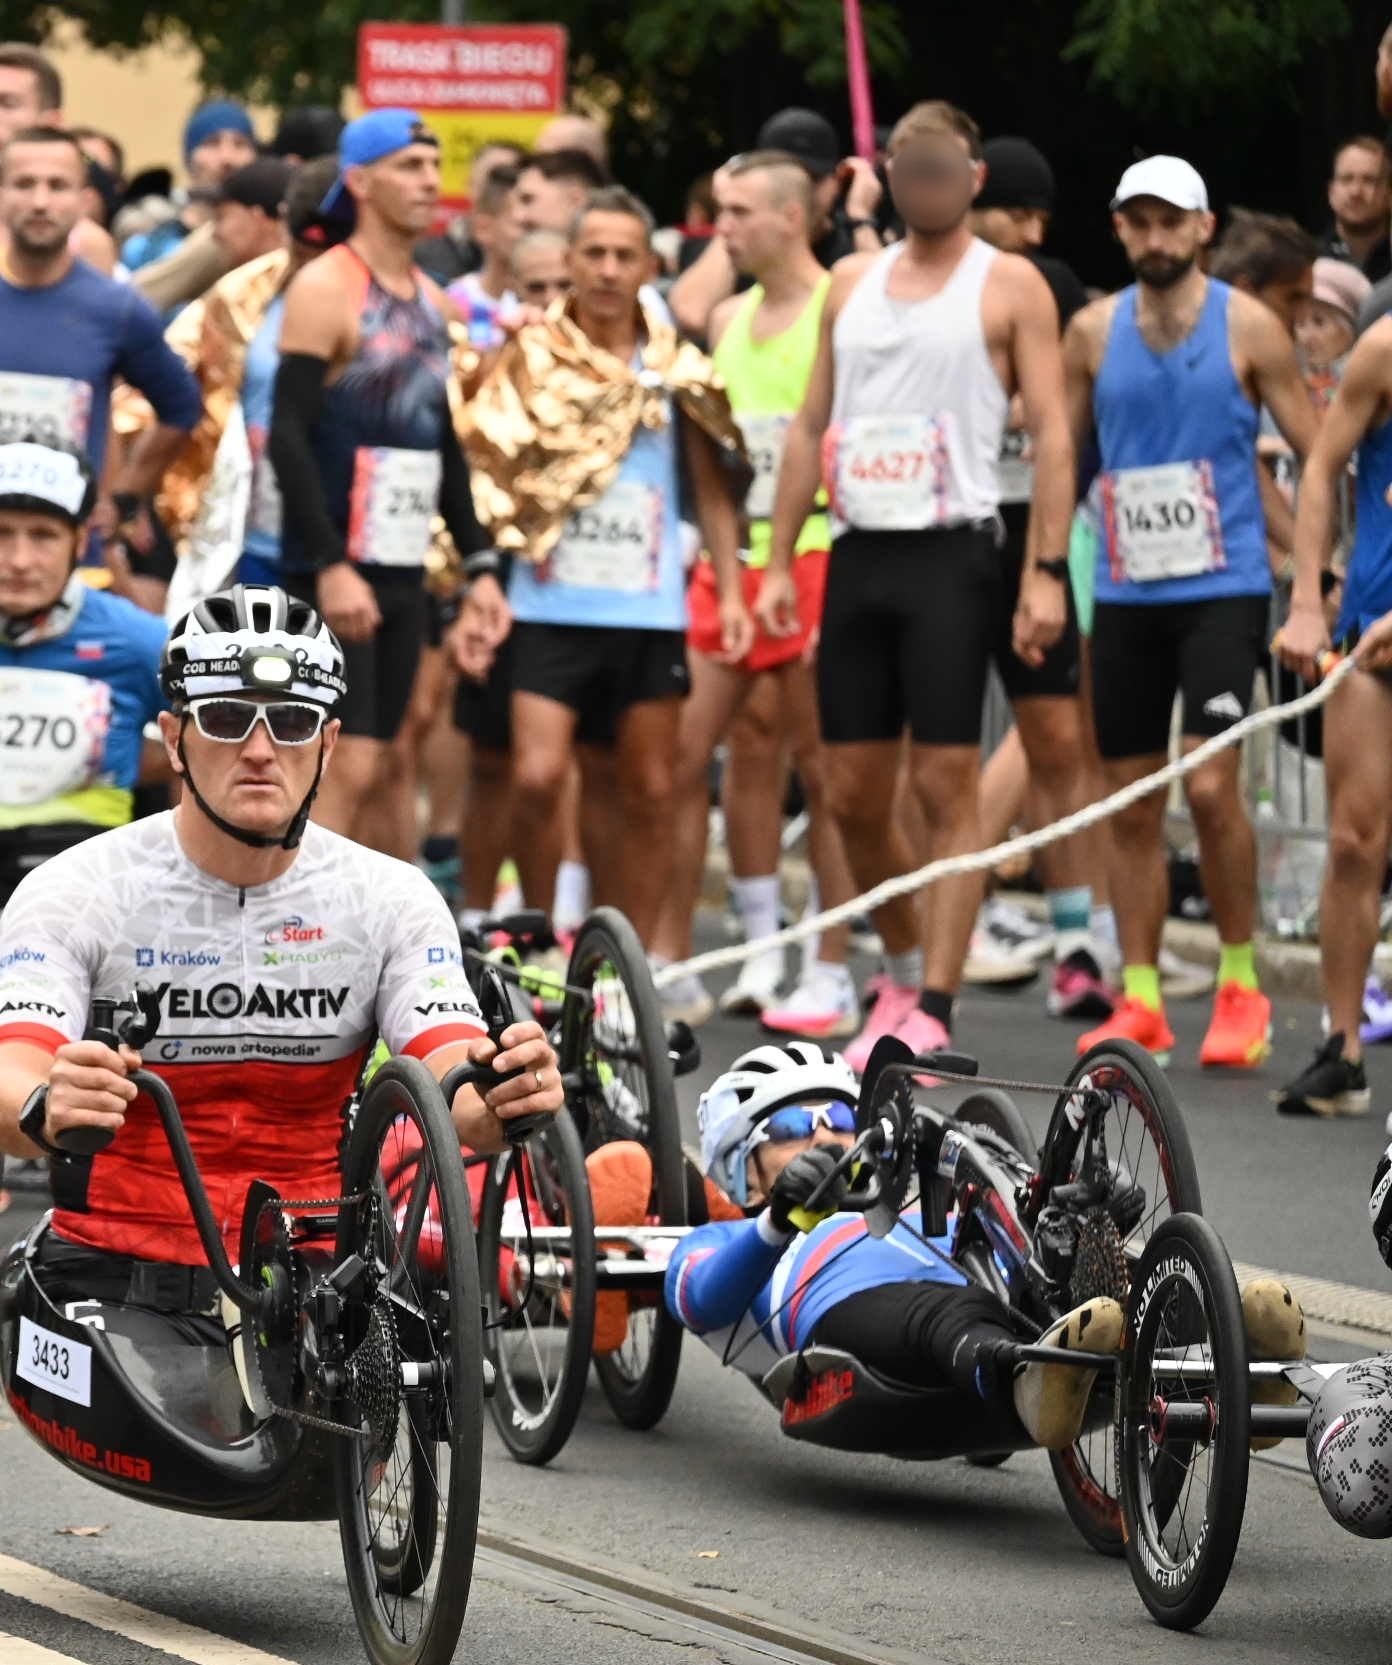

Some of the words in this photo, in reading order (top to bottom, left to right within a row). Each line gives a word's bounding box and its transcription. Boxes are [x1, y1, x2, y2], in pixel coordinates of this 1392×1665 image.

[851, 450, 926, 481] 4627
[1125, 499, 1195, 535] 1430
[282, 926, 323, 942] Start
[160, 949, 222, 967] Kraków
[191, 1043, 237, 1055] nowa
[31, 1334, 70, 1381] 3433
